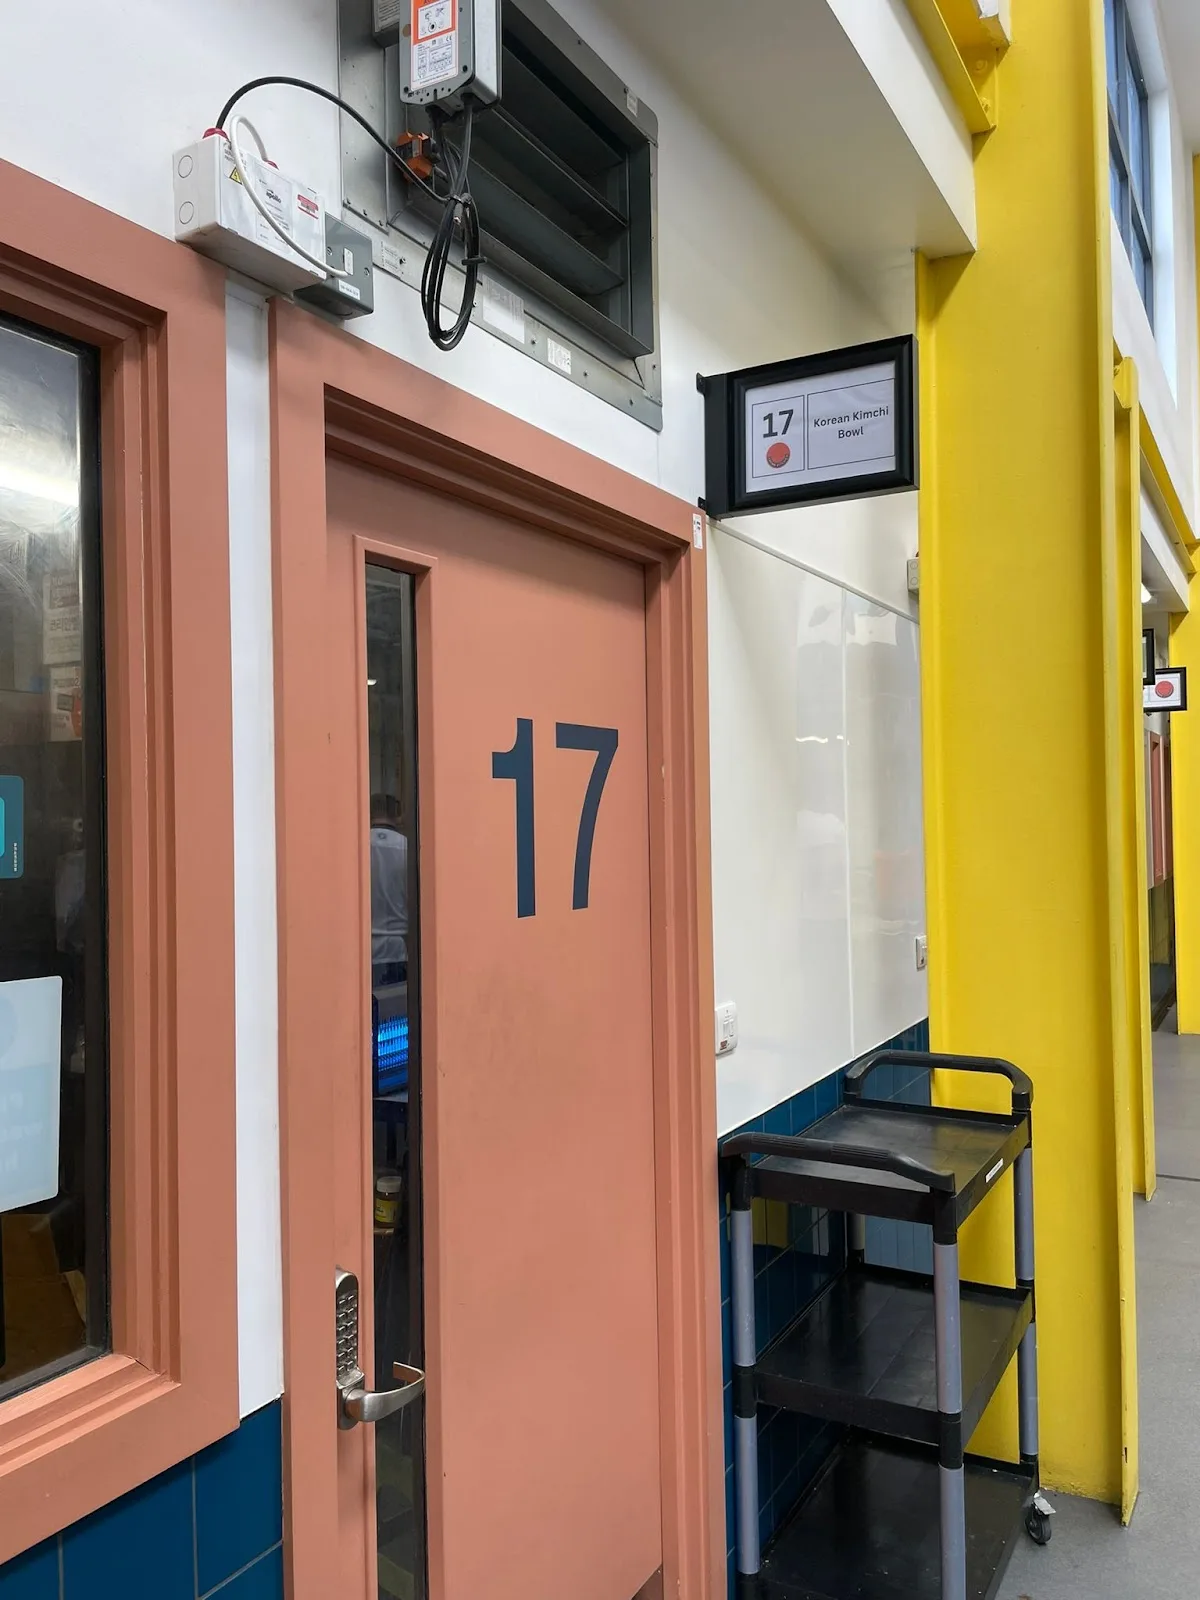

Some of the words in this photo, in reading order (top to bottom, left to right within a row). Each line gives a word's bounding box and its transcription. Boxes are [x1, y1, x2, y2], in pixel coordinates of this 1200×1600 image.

[763, 408, 794, 438] 17
[813, 414, 850, 428] Korean
[852, 405, 889, 421] Kimchi
[838, 426, 864, 439] Bowl
[492, 718, 619, 918] 17
